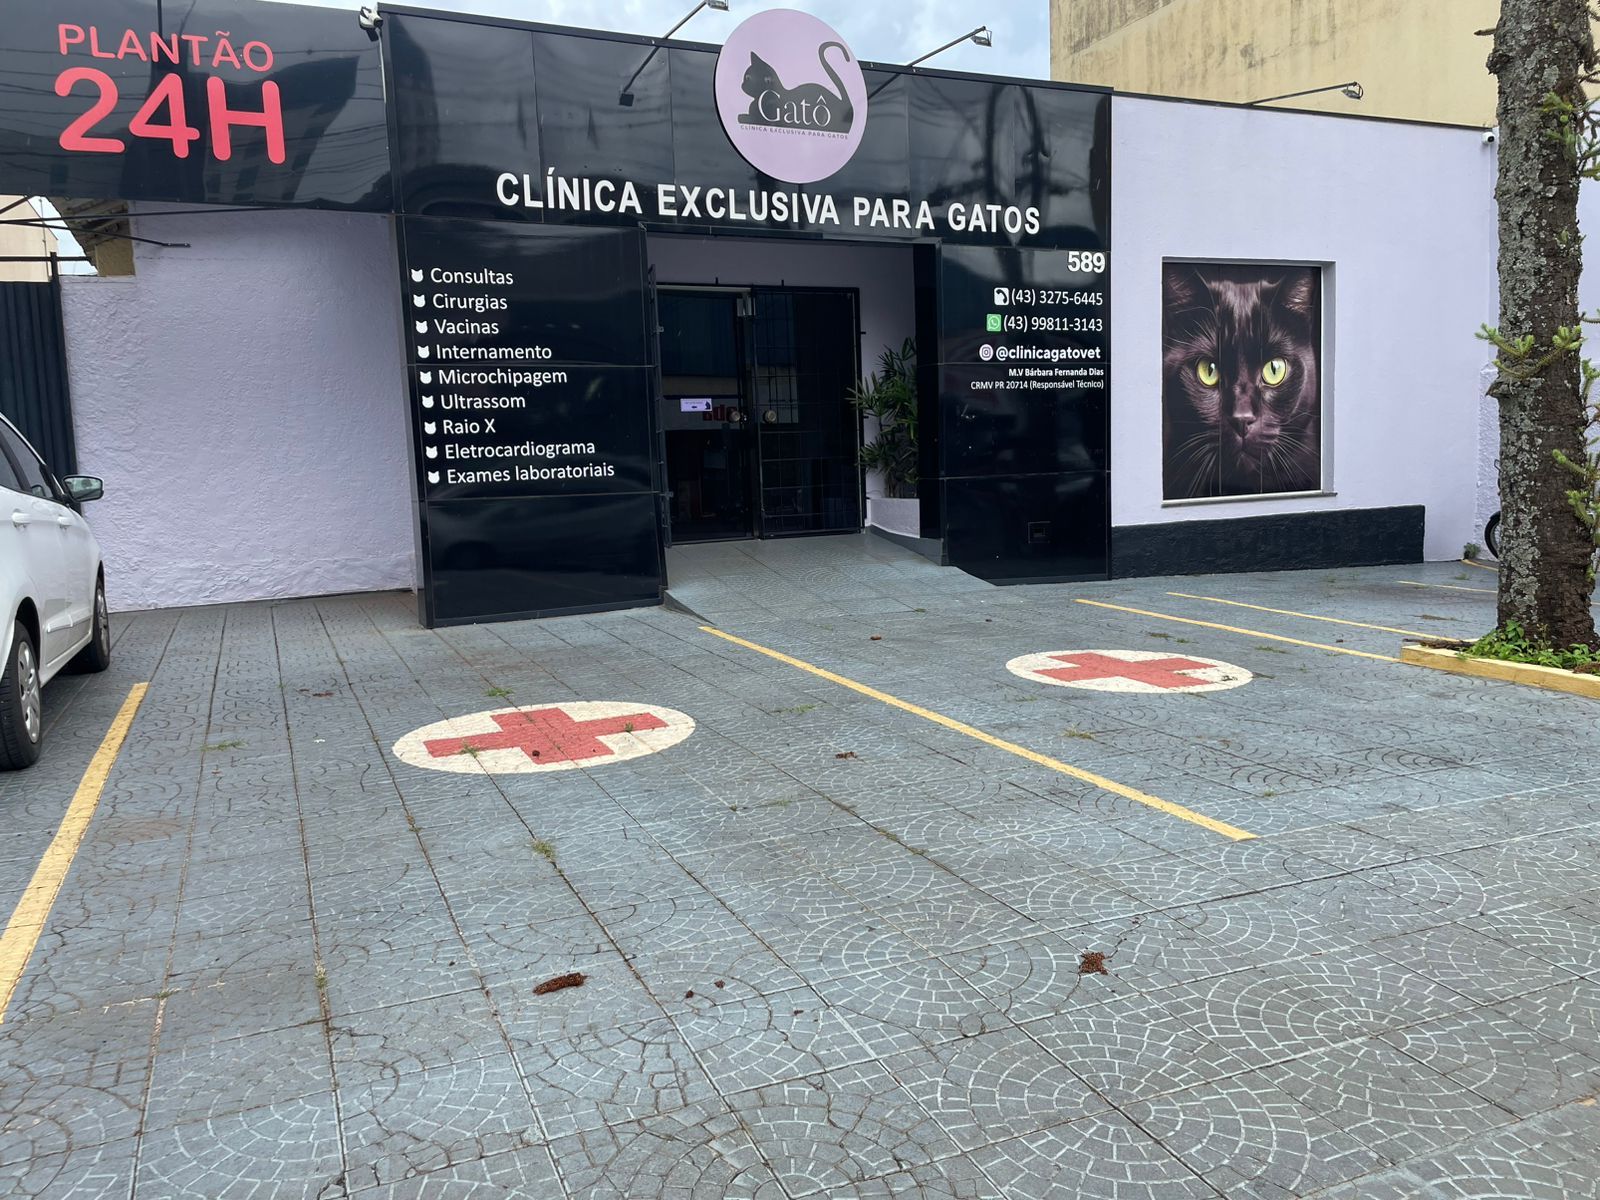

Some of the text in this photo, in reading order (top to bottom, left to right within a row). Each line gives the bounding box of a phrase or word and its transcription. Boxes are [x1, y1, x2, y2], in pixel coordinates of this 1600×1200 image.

[58, 23, 274, 72] PLANTÃO
[54, 66, 286, 165] 24H
[758, 90, 831, 127] Gatô
[770, 128, 806, 136] EXCLUSIVA
[496, 167, 1041, 236] CLÍNICA EXCLUSIVA PARA GATOS
[1067, 251, 1106, 274] 589
[430, 267, 514, 285] Consultas
[432, 293, 508, 312] Cirurgias
[1011, 288, 1103, 306] (43) 3275-6445
[434, 319, 500, 334] Vacinas
[1003, 314, 1103, 333] (43) 99811-3143
[436, 344, 553, 360] Internamento
[995, 345, 1102, 362] @clinicagatovet
[438, 368, 568, 387] Microchipagem
[1024, 367, 1053, 377] Bárbara
[1054, 367, 1088, 377] Fernanda
[1088, 367, 1105, 377] Dias
[970, 379, 1104, 390] CRMV PR 20714 (Responsável Técnico)
[440, 393, 526, 410] Ultrassom
[442, 418, 496, 435] Raio X
[445, 441, 596, 460] Eletrocardiograma
[447, 462, 615, 484] Exames laboratoriais
